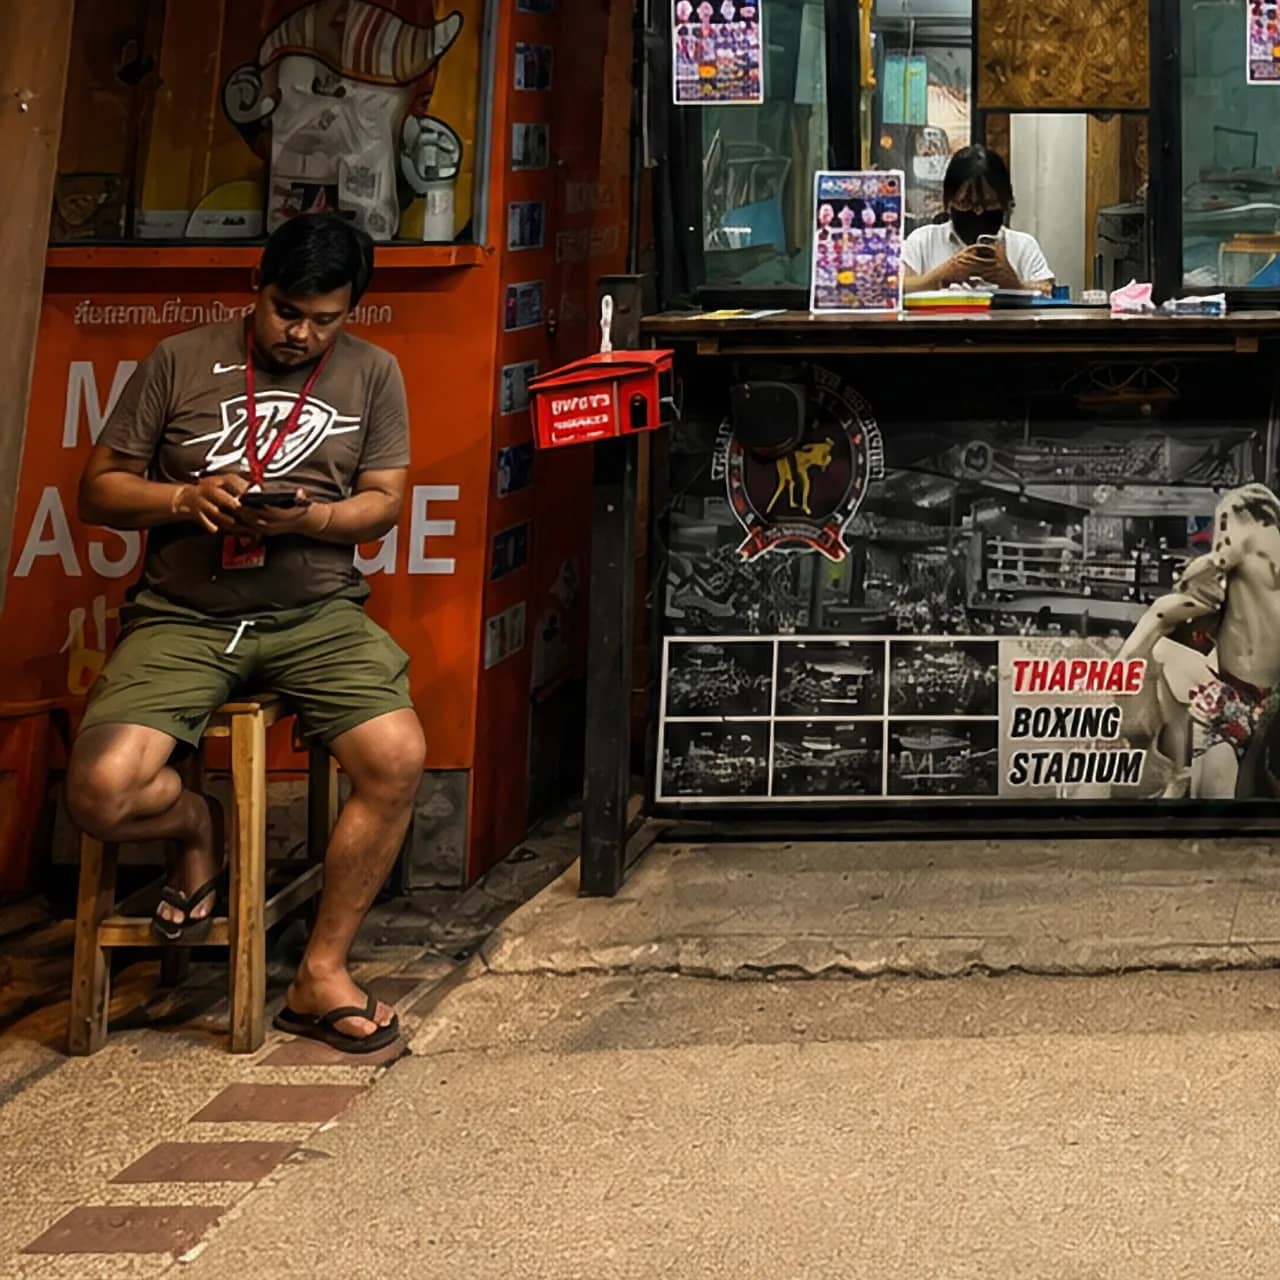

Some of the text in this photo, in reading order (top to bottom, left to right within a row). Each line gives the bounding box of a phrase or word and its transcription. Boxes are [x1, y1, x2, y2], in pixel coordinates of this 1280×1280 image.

[1012, 658, 1147, 694] THAPHAE
[1010, 705, 1121, 739] BOXING
[1008, 750, 1146, 786] STADIUM
